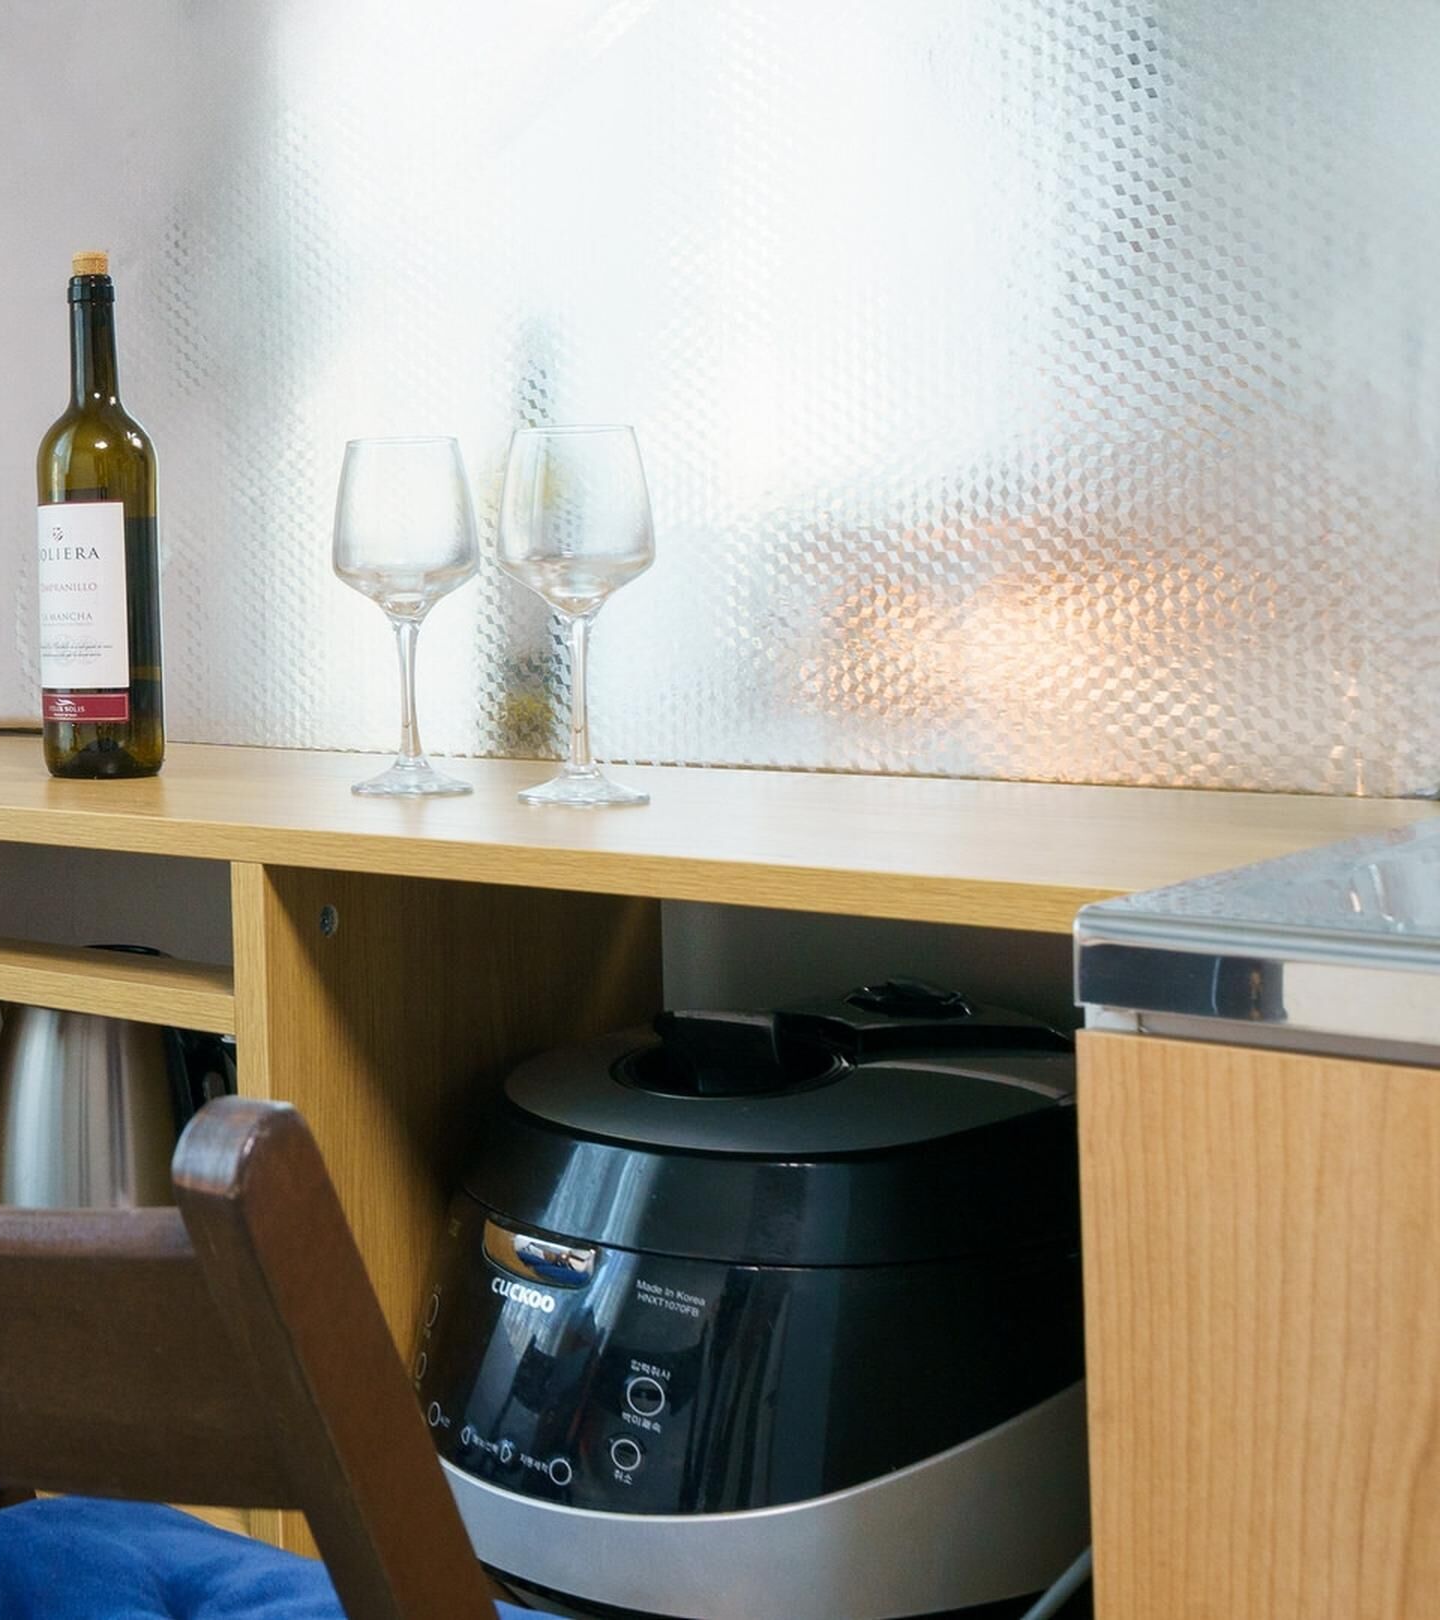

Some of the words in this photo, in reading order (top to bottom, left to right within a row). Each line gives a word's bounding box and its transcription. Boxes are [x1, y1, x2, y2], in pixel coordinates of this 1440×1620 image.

[491, 1276, 556, 1313] CUCKOO
[636, 1279, 663, 1295] Made
[675, 1290, 706, 1307] Korea
